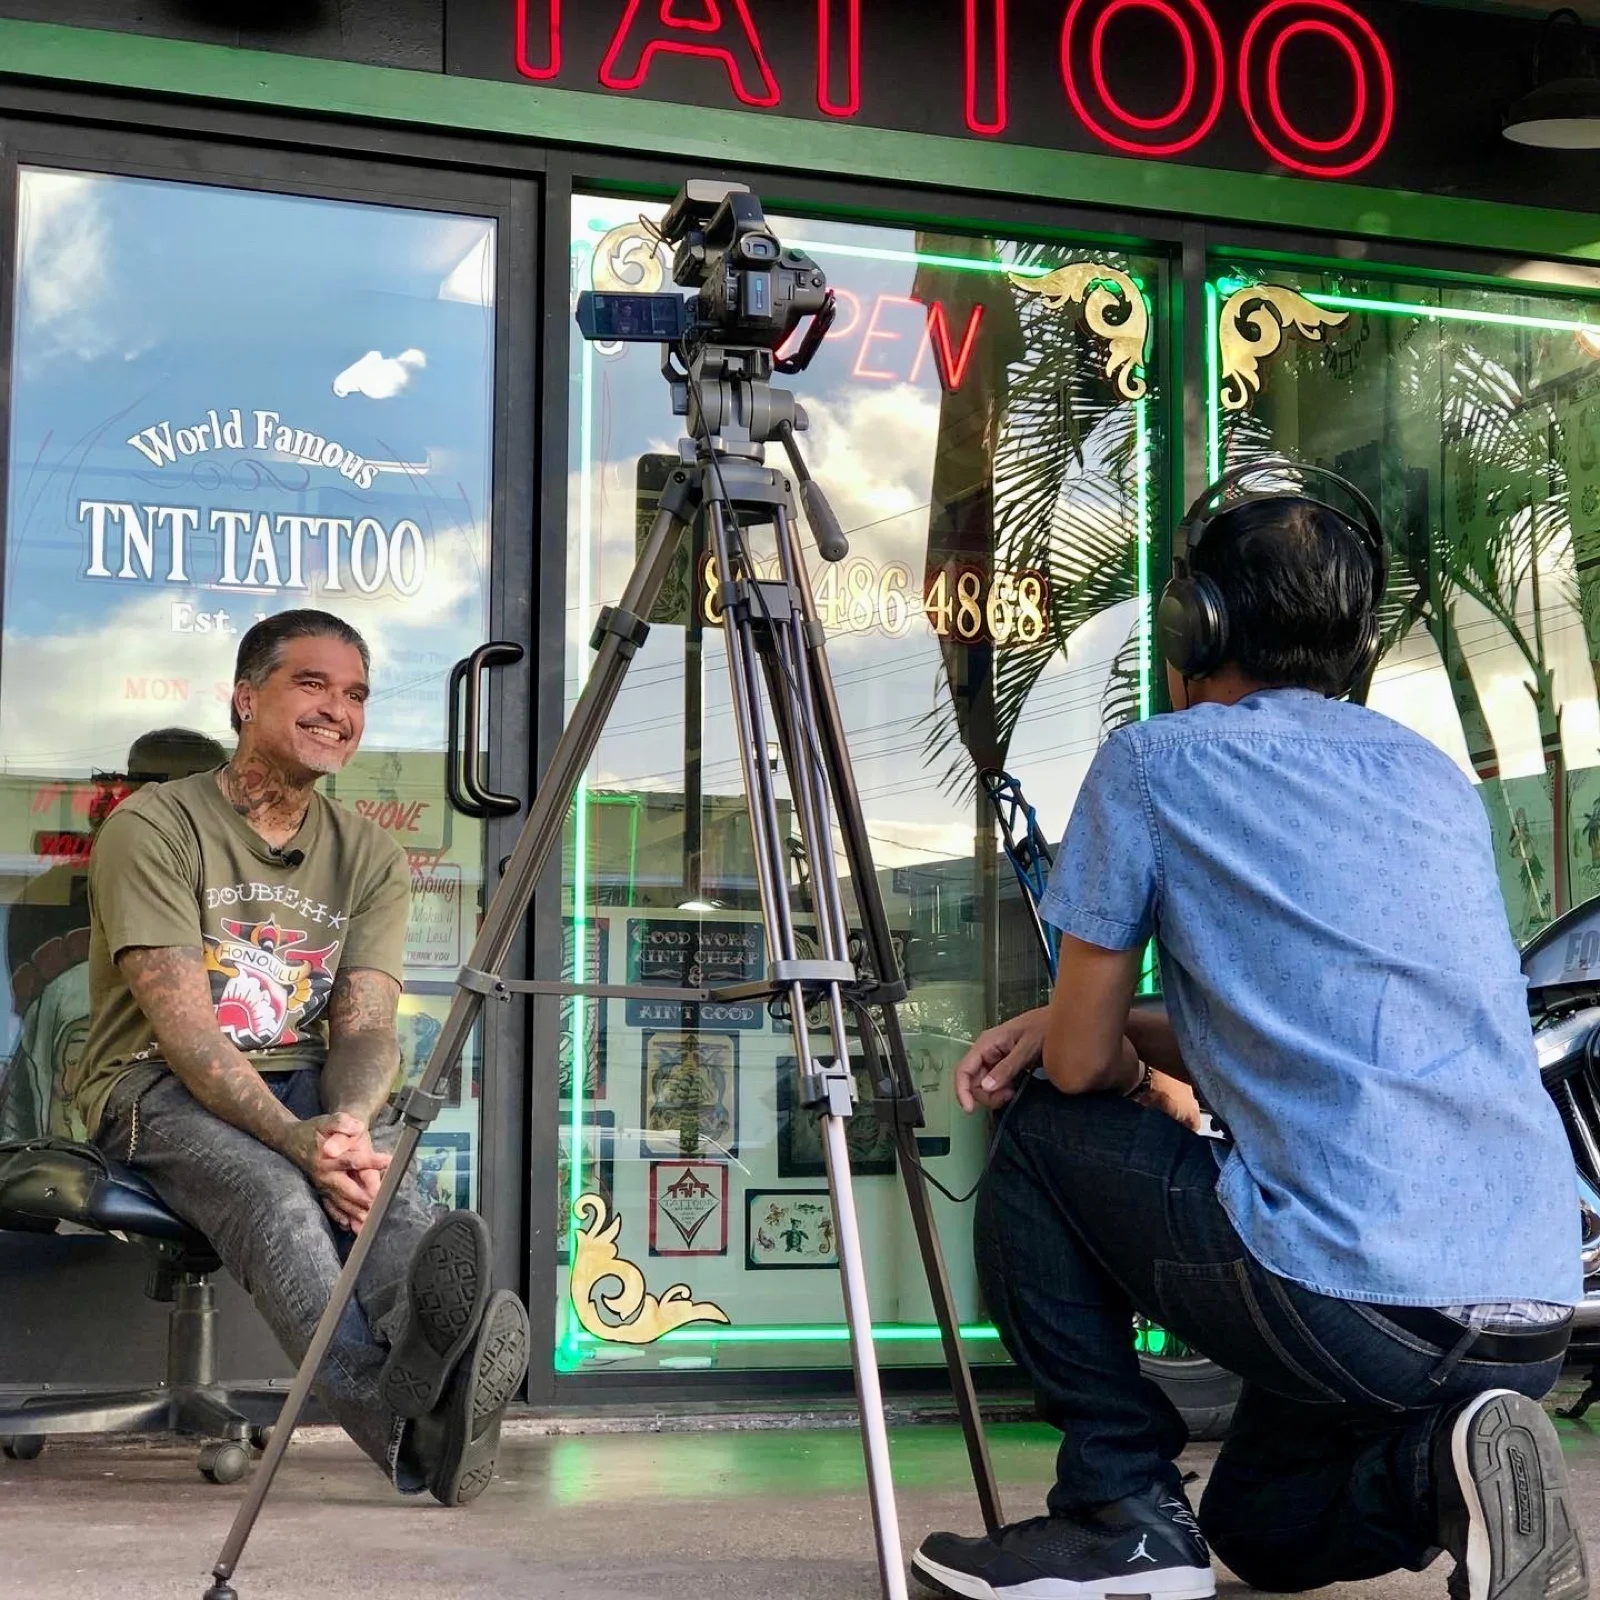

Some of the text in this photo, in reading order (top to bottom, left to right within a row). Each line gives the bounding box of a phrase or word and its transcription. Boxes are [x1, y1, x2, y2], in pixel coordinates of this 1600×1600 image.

[774, 288, 986, 392] PEN
[127, 408, 380, 489] World Famous
[79, 499, 427, 595] TNT TATTOO
[170, 601, 238, 634] Est.
[355, 799, 430, 832] SHOVE
[410, 875, 457, 903] ipping
[631, 925, 757, 949] GOOD WORK
[219, 947, 301, 982] HONOLULU
[639, 1005, 754, 1021] AIN'T GOOD
